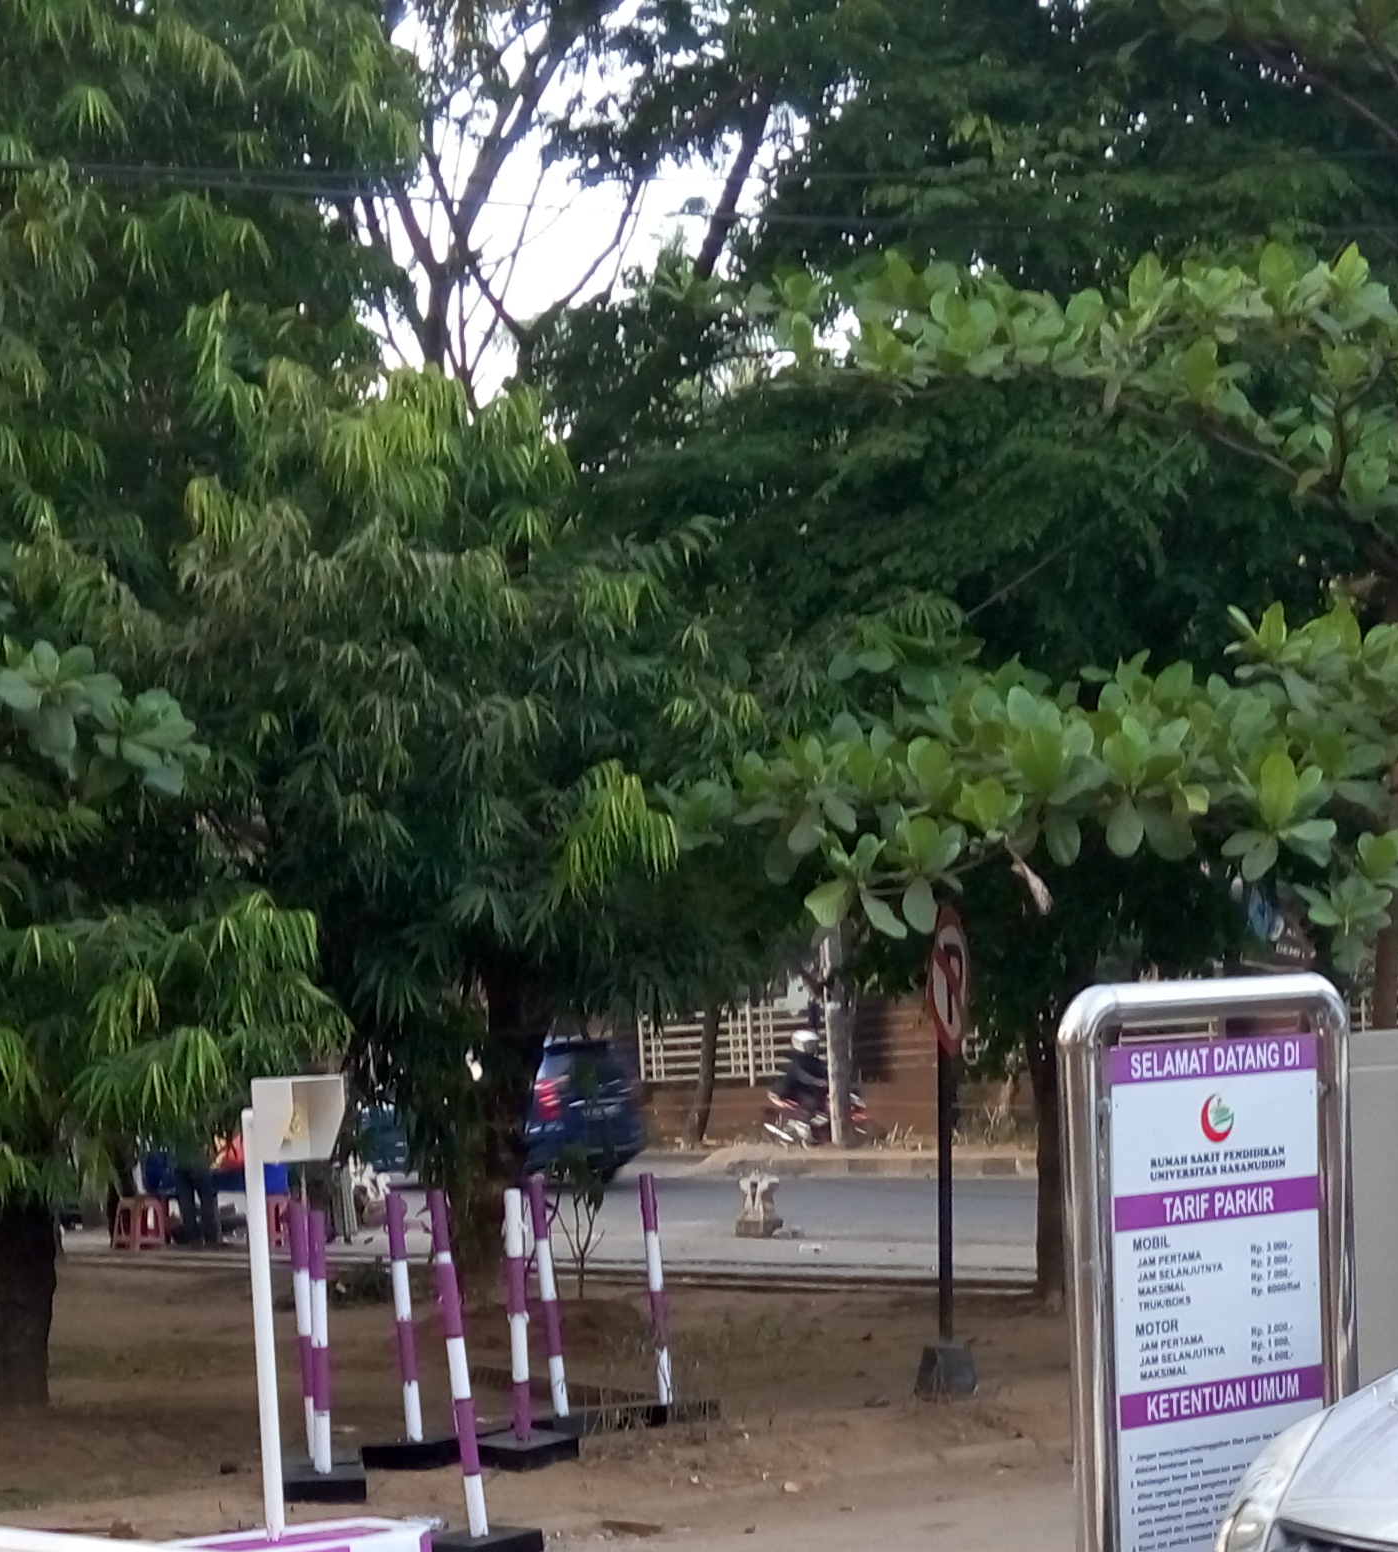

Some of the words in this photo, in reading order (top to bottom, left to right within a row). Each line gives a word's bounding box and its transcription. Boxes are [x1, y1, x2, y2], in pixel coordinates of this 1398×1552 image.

[1130, 1047, 1209, 1080] SELAMAT
[1213, 1043, 1280, 1073] DATANG
[1283, 1040, 1300, 1067] DI
[1150, 1154, 1188, 1169] RUMAH
[1190, 1151, 1221, 1165] SAKIT
[1223, 1145, 1286, 1161] PENDIDIKAN
[1150, 1164, 1218, 1182] UNIVERSITAS
[1220, 1157, 1286, 1174] HASANUDDIN
[1163, 1192, 1210, 1223] TARIF
[1214, 1186, 1274, 1217] PARKIR
[1132, 1234, 1170, 1251] MOBIL
[1137, 1255, 1156, 1269] JAM
[1158, 1250, 1202, 1266] PERTAMA
[1137, 1269, 1157, 1283] JAM
[1159, 1262, 1224, 1280] SELANJUTNYA
[1137, 1281, 1186, 1297] MAKSIMAL
[1135, 1318, 1179, 1338] MOTOR
[1139, 1339, 1158, 1353] JAM
[1160, 1334, 1204, 1350] PERTAMA
[1139, 1353, 1159, 1368] JAM
[1161, 1345, 1226, 1364] SELANJUTNYA
[1139, 1365, 1188, 1382] MAKSIMAL
[1146, 1379, 1247, 1422] KETENTUAN
[1251, 1372, 1300, 1404] UMUM
